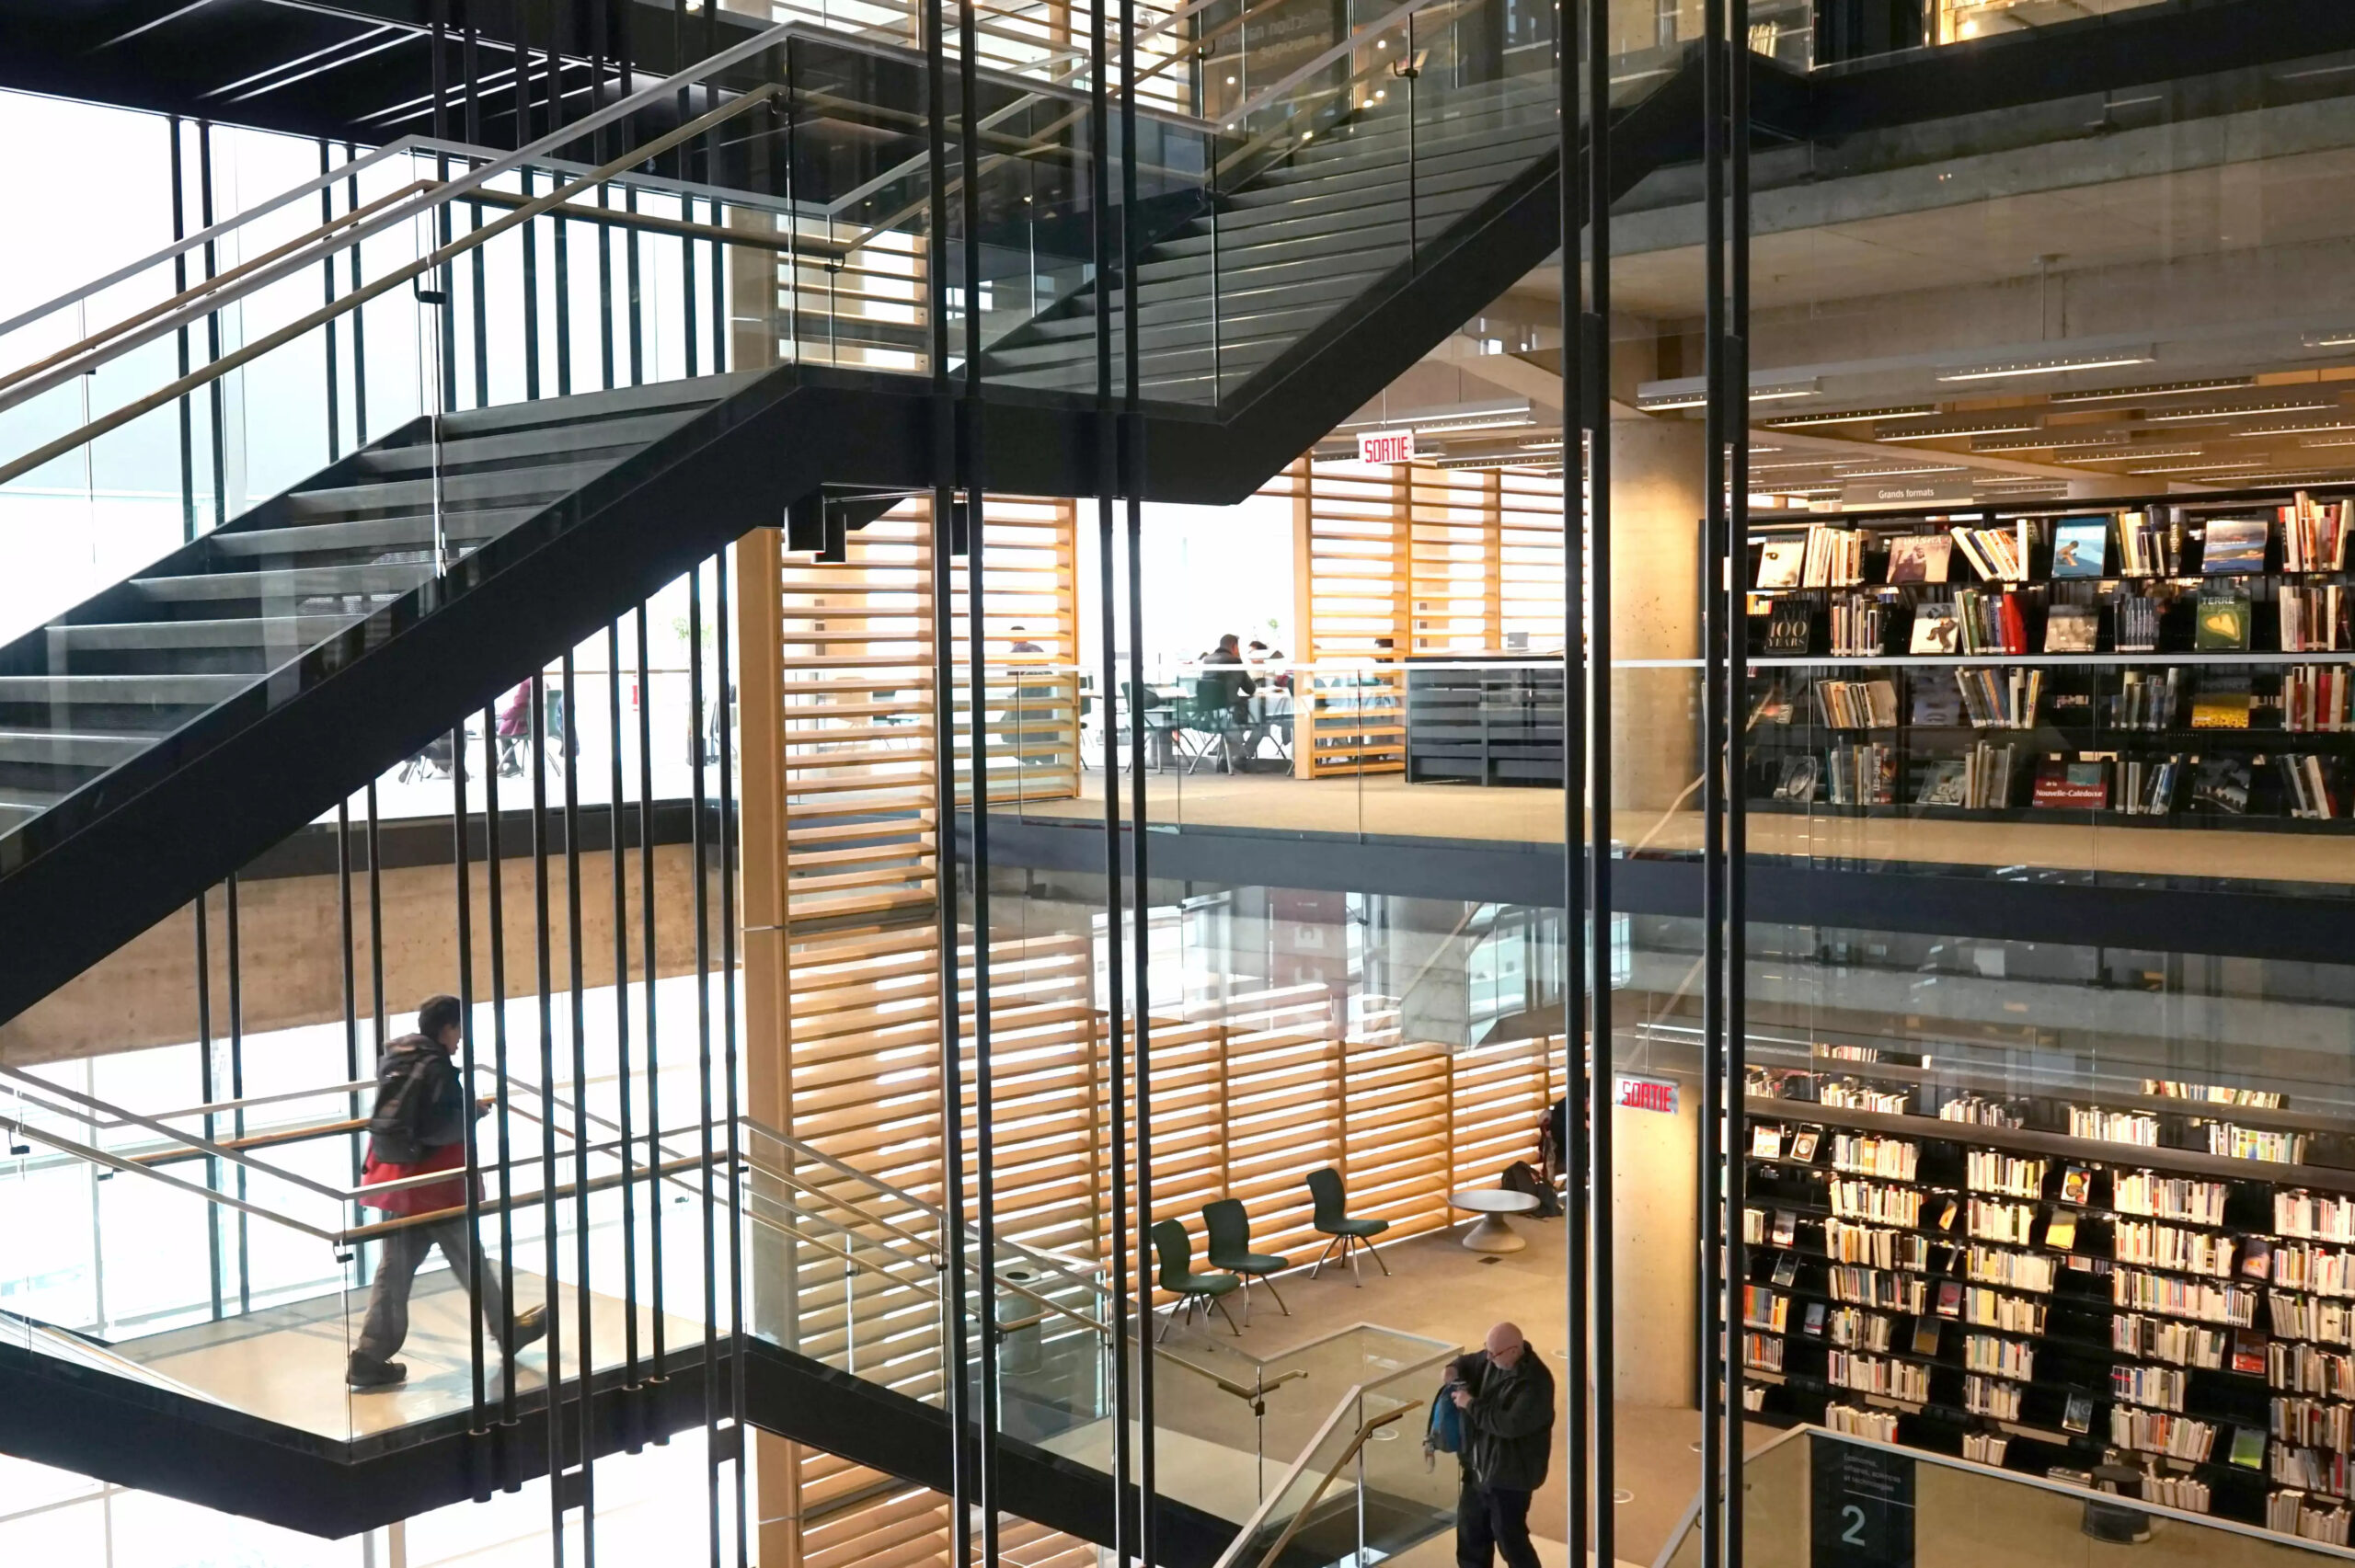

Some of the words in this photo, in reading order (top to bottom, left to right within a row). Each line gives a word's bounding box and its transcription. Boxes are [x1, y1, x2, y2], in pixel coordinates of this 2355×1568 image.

[1364, 436, 1408, 464] SORTIE
[1878, 488, 1904, 499] Grands
[1906, 487, 1935, 498] formats
[2201, 596, 2235, 605] TERRE
[1770, 621, 1808, 637] 100
[1767, 637, 1805, 647] YEARS
[1622, 1081, 1672, 1112] SORTIE
[1841, 1504, 1866, 1547] 2
